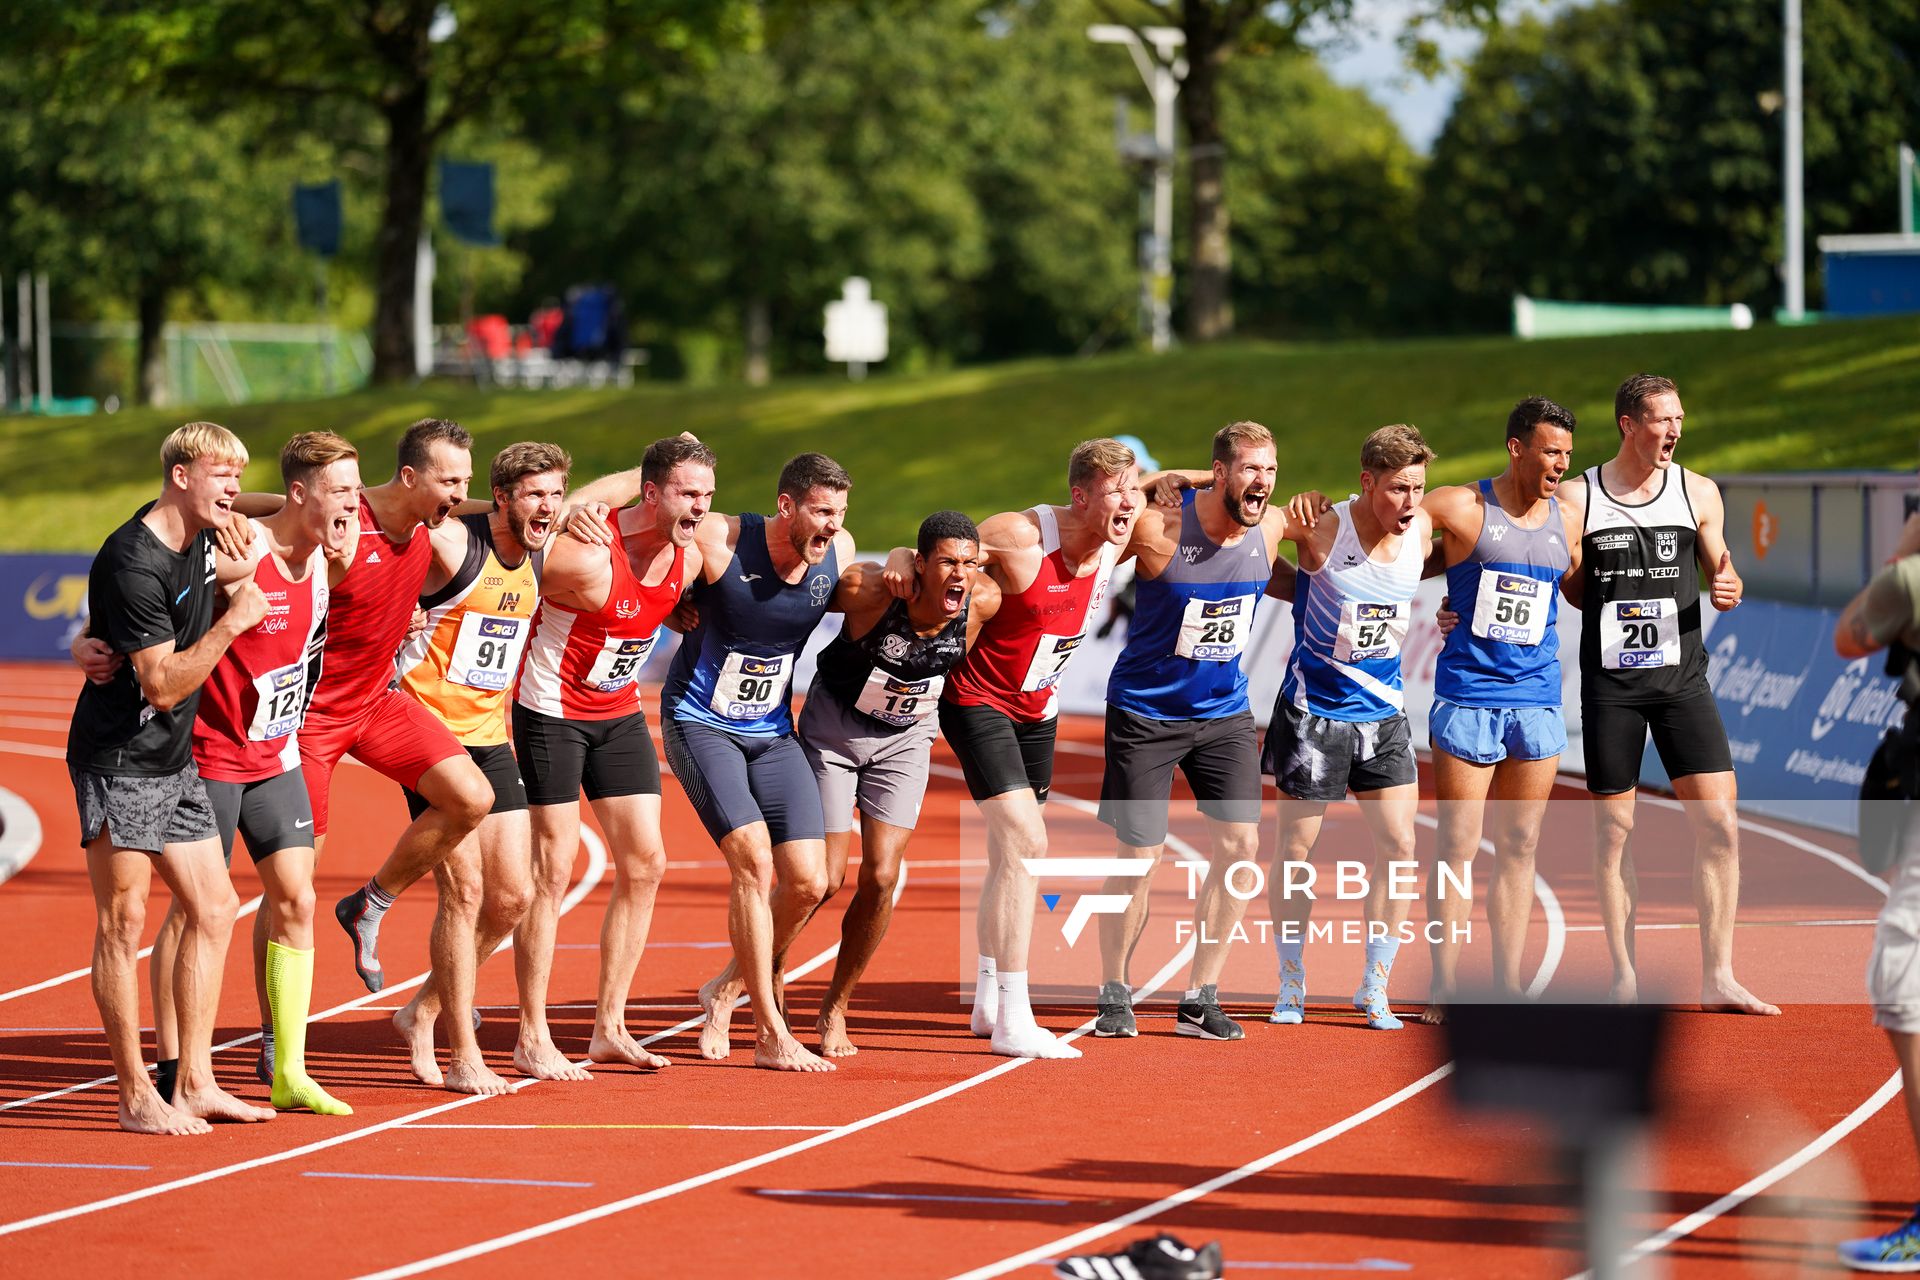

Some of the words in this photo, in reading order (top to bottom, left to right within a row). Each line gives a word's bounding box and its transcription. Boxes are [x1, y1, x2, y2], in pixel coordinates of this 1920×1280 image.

[1627, 568, 1645, 577] UNO
[1650, 568, 1679, 578] TEVA
[1519, 582, 1537, 594] GLS
[616, 600, 630, 609] LG
[810, 598, 828, 607] LAV
[1223, 603, 1239, 613] GLS
[1495, 596, 1531, 626] 56
[1641, 606, 1658, 617] GLS
[256, 617, 289, 635] Nobis
[501, 625, 517, 637] GLS
[1199, 619, 1236, 644] 28
[1357, 621, 1389, 649] 52
[1506, 628, 1529, 639] PLAN
[1622, 622, 1659, 650] 20
[476, 640, 508, 670] 91
[1211, 646, 1235, 655] PLAN
[1637, 652, 1663, 662] PLAN
[608, 656, 641, 679] 55
[764, 662, 780, 674] GLS
[483, 673, 506, 685] PLAN
[737, 678, 773, 702] 90
[909, 684, 927, 694] GLS
[268, 684, 304, 722] 123
[745, 703, 769, 714] PLAN
[885, 695, 919, 714] 19
